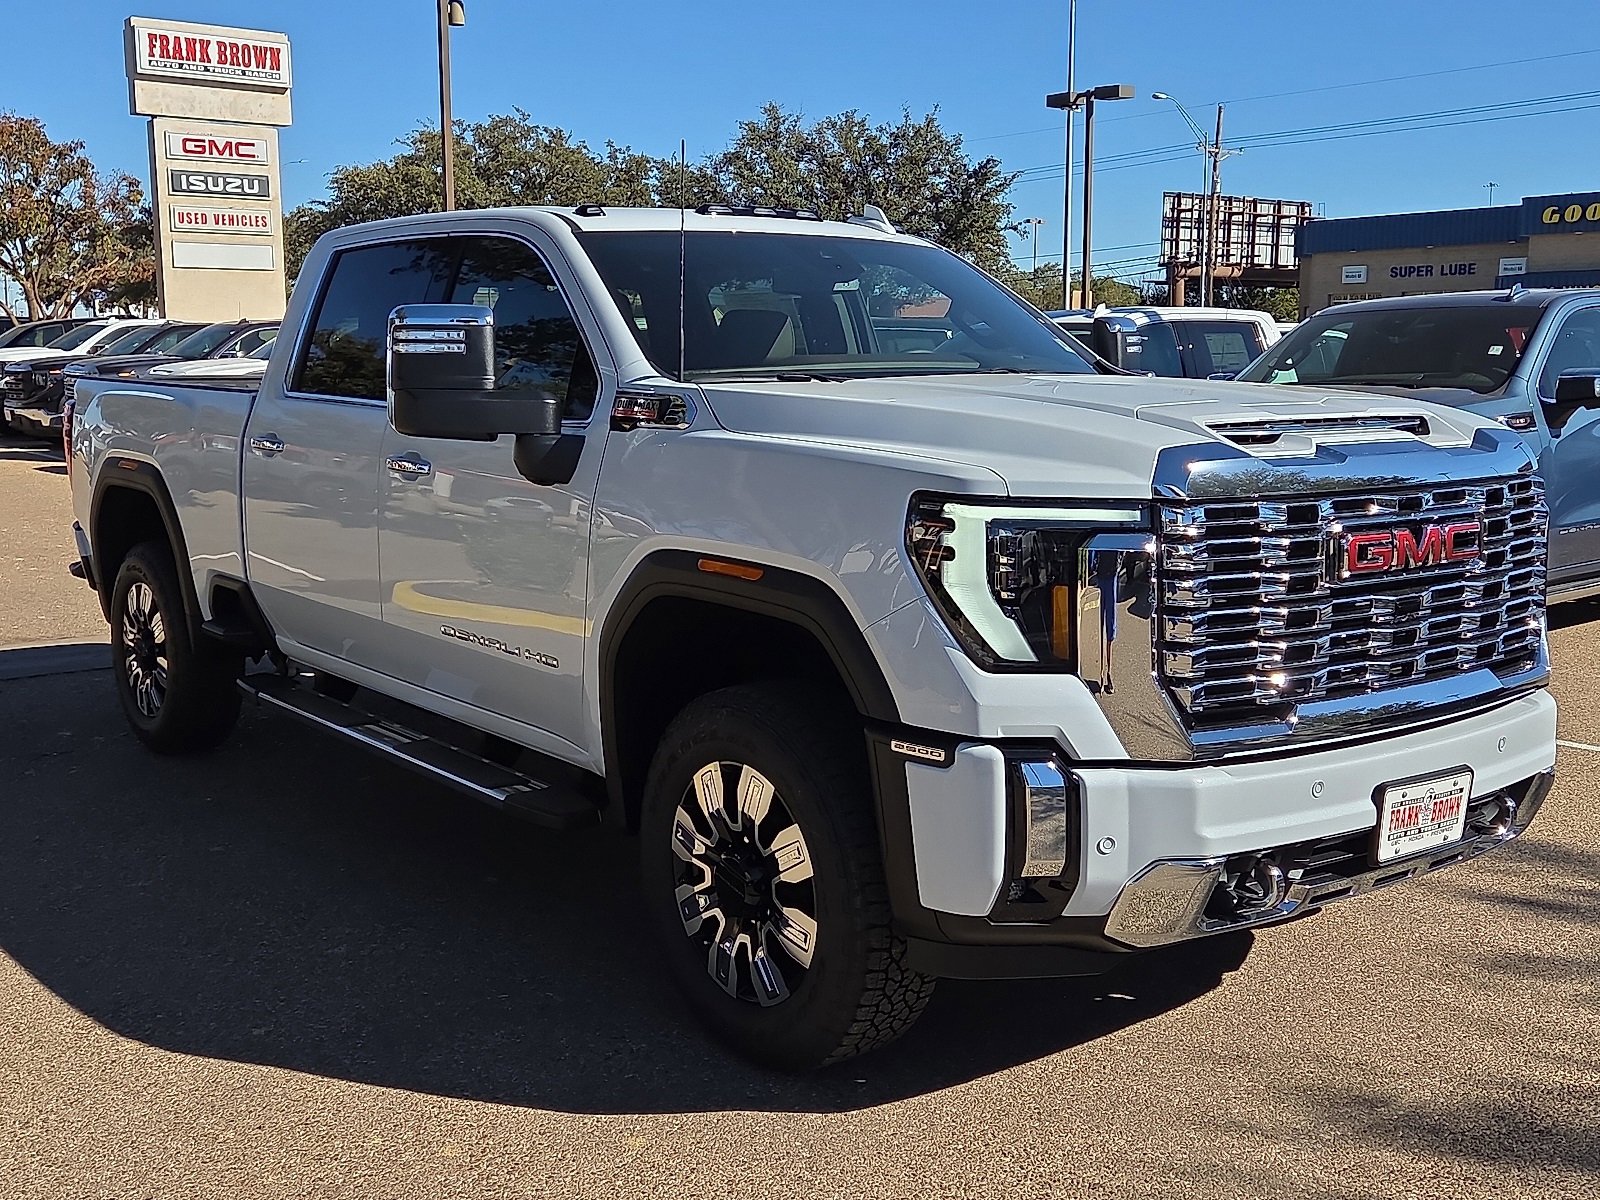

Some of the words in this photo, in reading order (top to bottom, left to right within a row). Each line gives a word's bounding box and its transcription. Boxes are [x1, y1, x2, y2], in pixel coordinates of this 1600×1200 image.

[147, 33, 212, 64] FRANK
[217, 41, 281, 71] BROWN
[150, 60, 179, 69] AUTO
[182, 63, 205, 71] AND
[206, 66, 243, 76] TRUCK
[244, 70, 280, 80] RANCH
[181, 137, 256, 158] GMC
[180, 174, 260, 194] ISUZU
[178, 212, 207, 225] USED
[213, 213, 268, 228] VEHICLES
[1389, 264, 1434, 278] SUPER
[1440, 262, 1477, 277] LUBE
[1347, 522, 1481, 573] GMC
[440, 624, 521, 657] DENALI
[524, 648, 560, 668] HD
[892, 742, 943, 759] 2500
[1388, 804, 1422, 832] FRANK
[1431, 795, 1464, 823] BROWN
